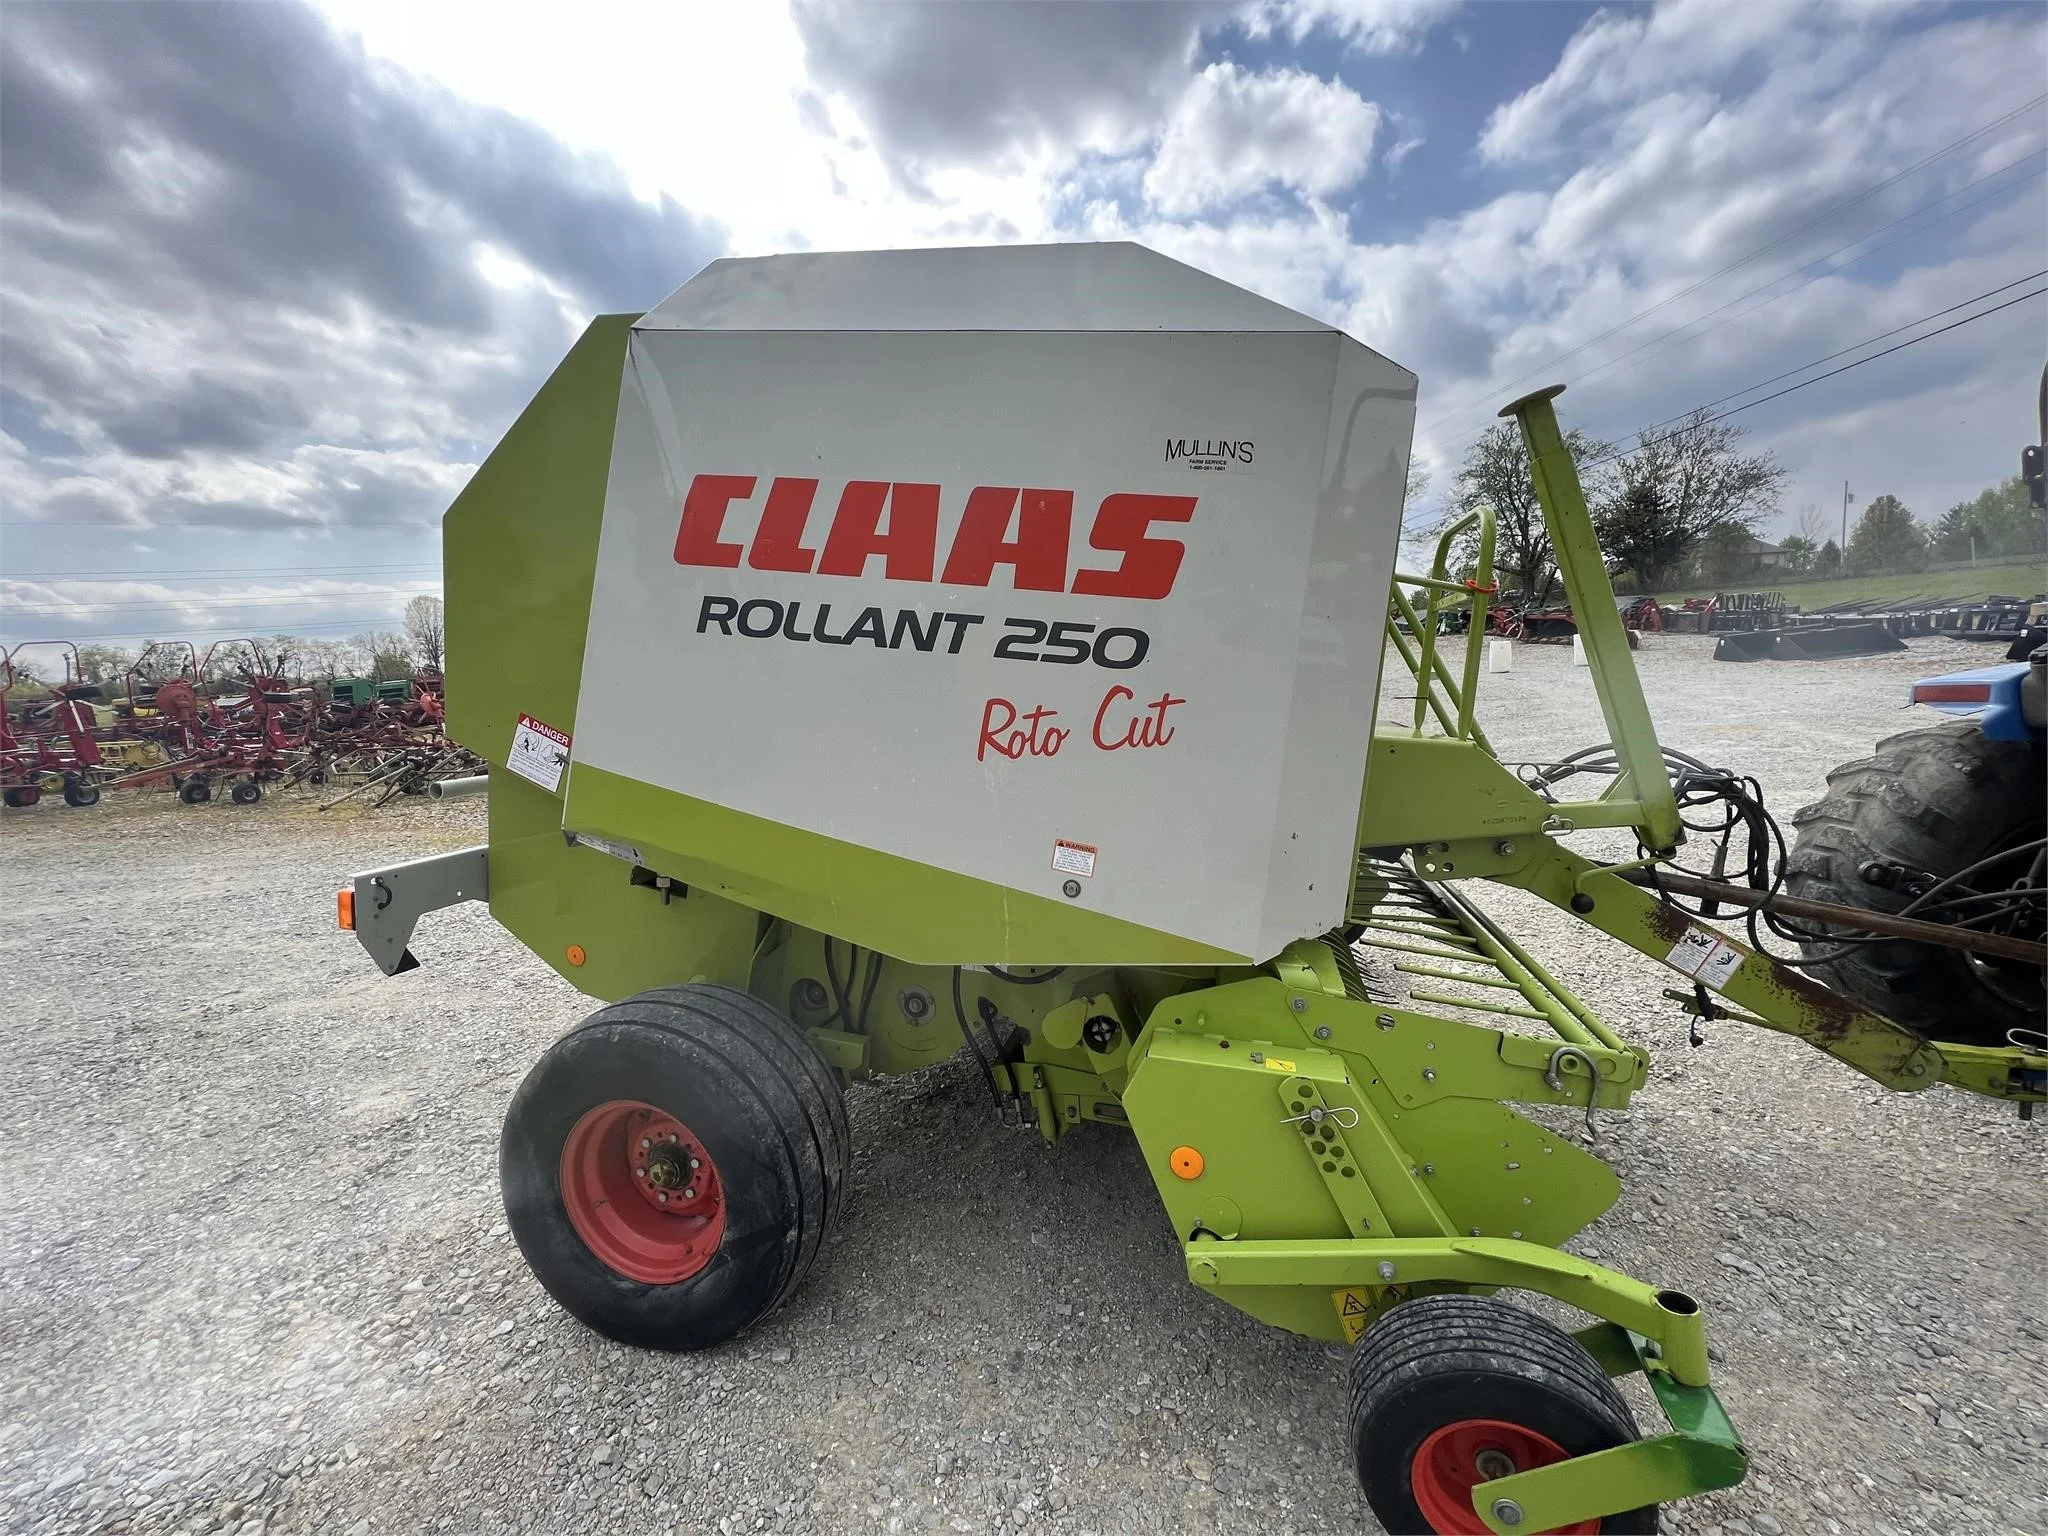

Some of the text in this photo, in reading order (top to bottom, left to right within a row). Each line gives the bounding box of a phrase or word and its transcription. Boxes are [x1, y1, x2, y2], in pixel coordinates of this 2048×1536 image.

[1165, 438, 1255, 464] MULLIN'S
[673, 473, 1199, 601] CLAAS
[696, 595, 1151, 670] ROLLANT 250
[532, 721, 569, 746] DANGER
[977, 684, 1187, 762] Roto Cut
[1065, 841, 1095, 853] WARNING
